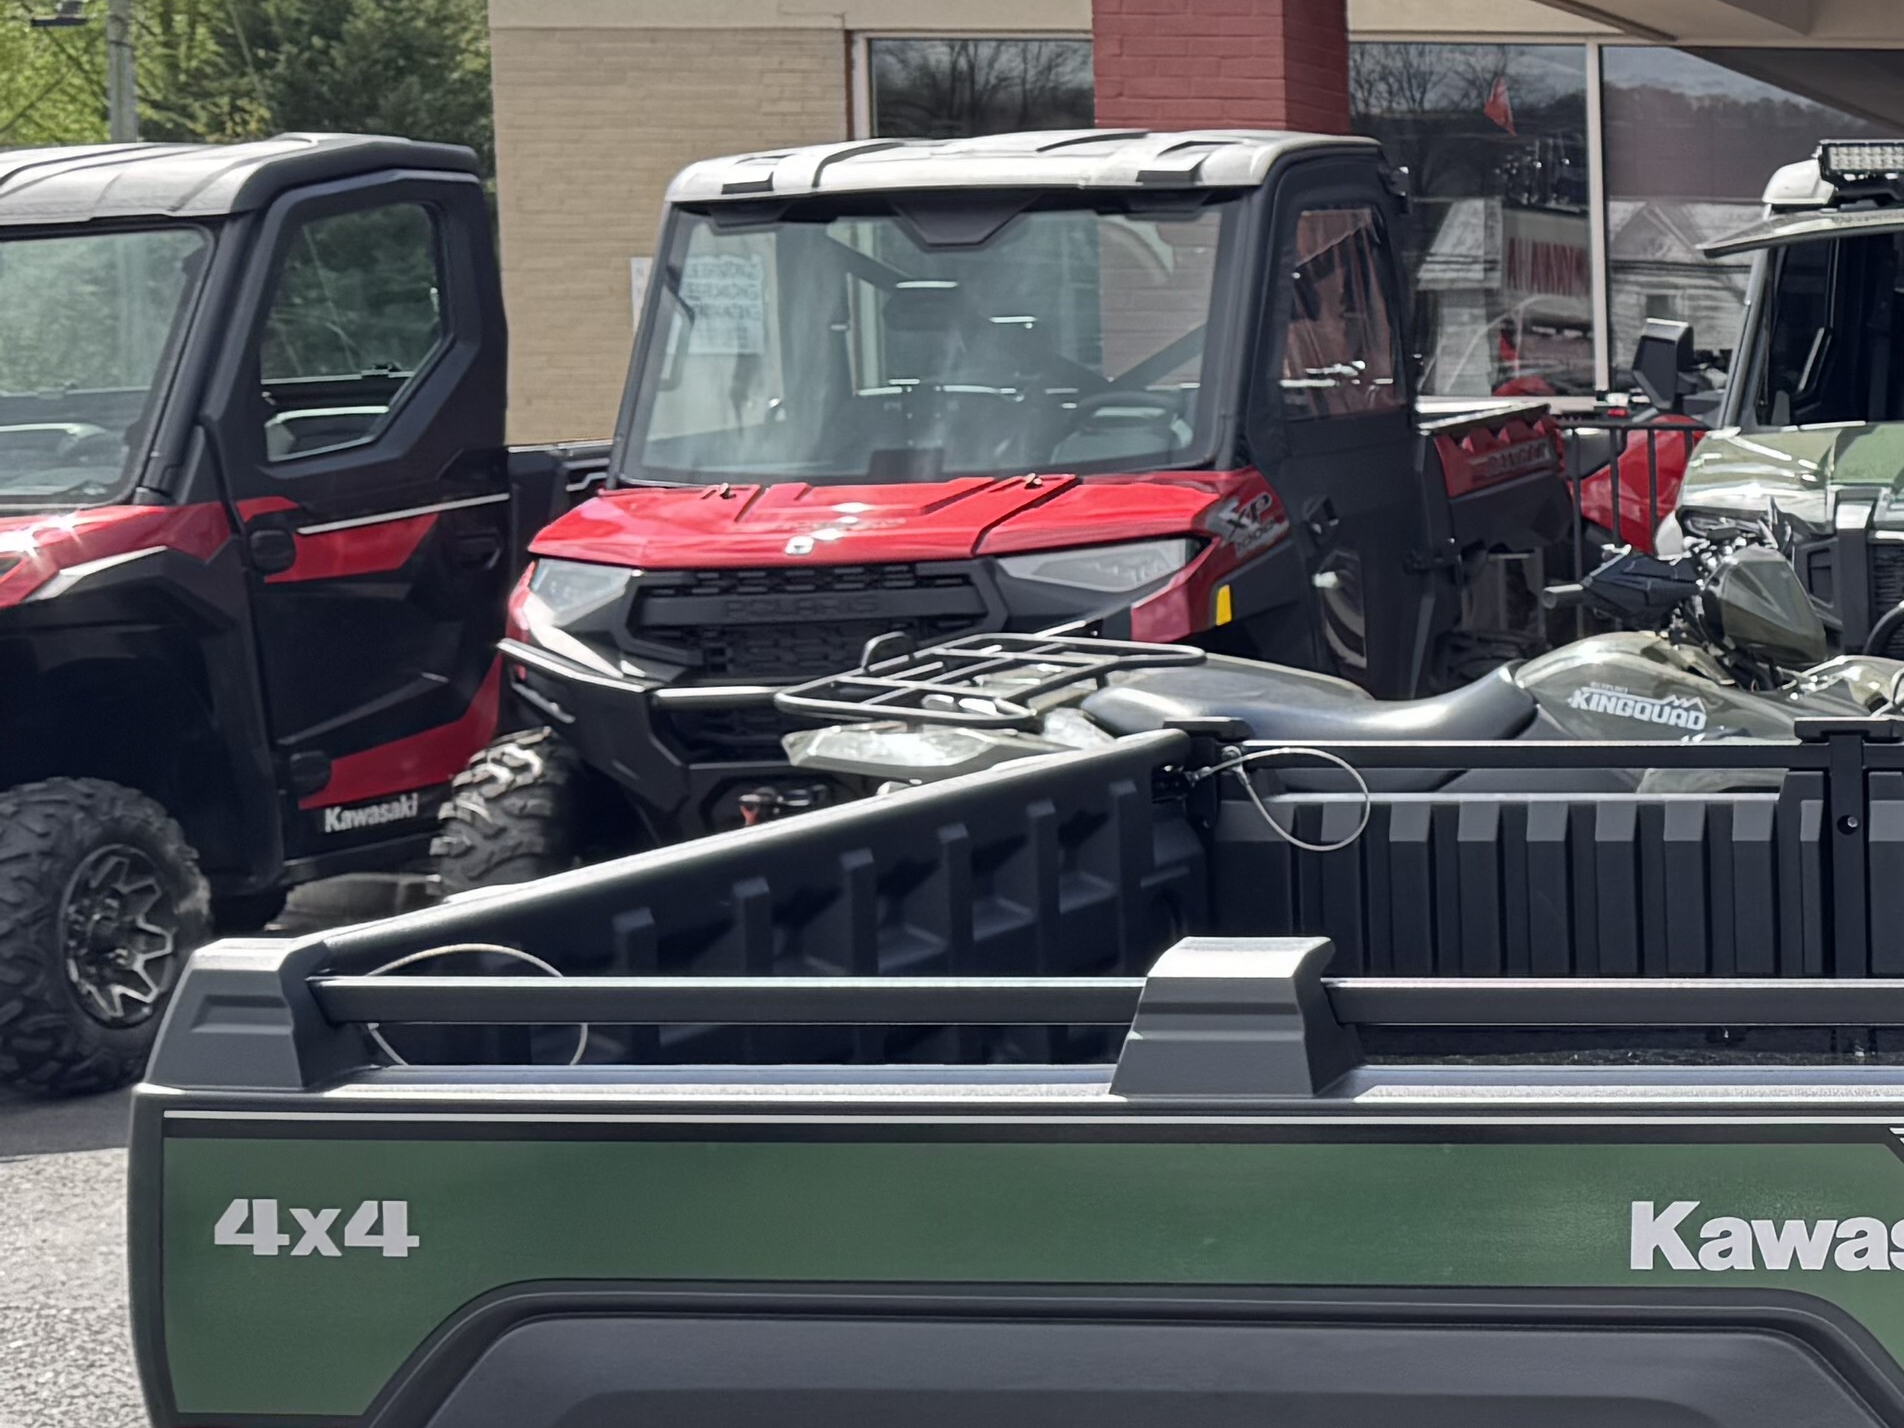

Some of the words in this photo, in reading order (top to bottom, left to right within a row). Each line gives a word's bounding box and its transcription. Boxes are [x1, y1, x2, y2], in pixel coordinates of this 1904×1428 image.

[1568, 689, 1707, 731] KINGQUAD
[325, 792, 418, 832] Kawasaki
[214, 1198, 420, 1257] 4x4
